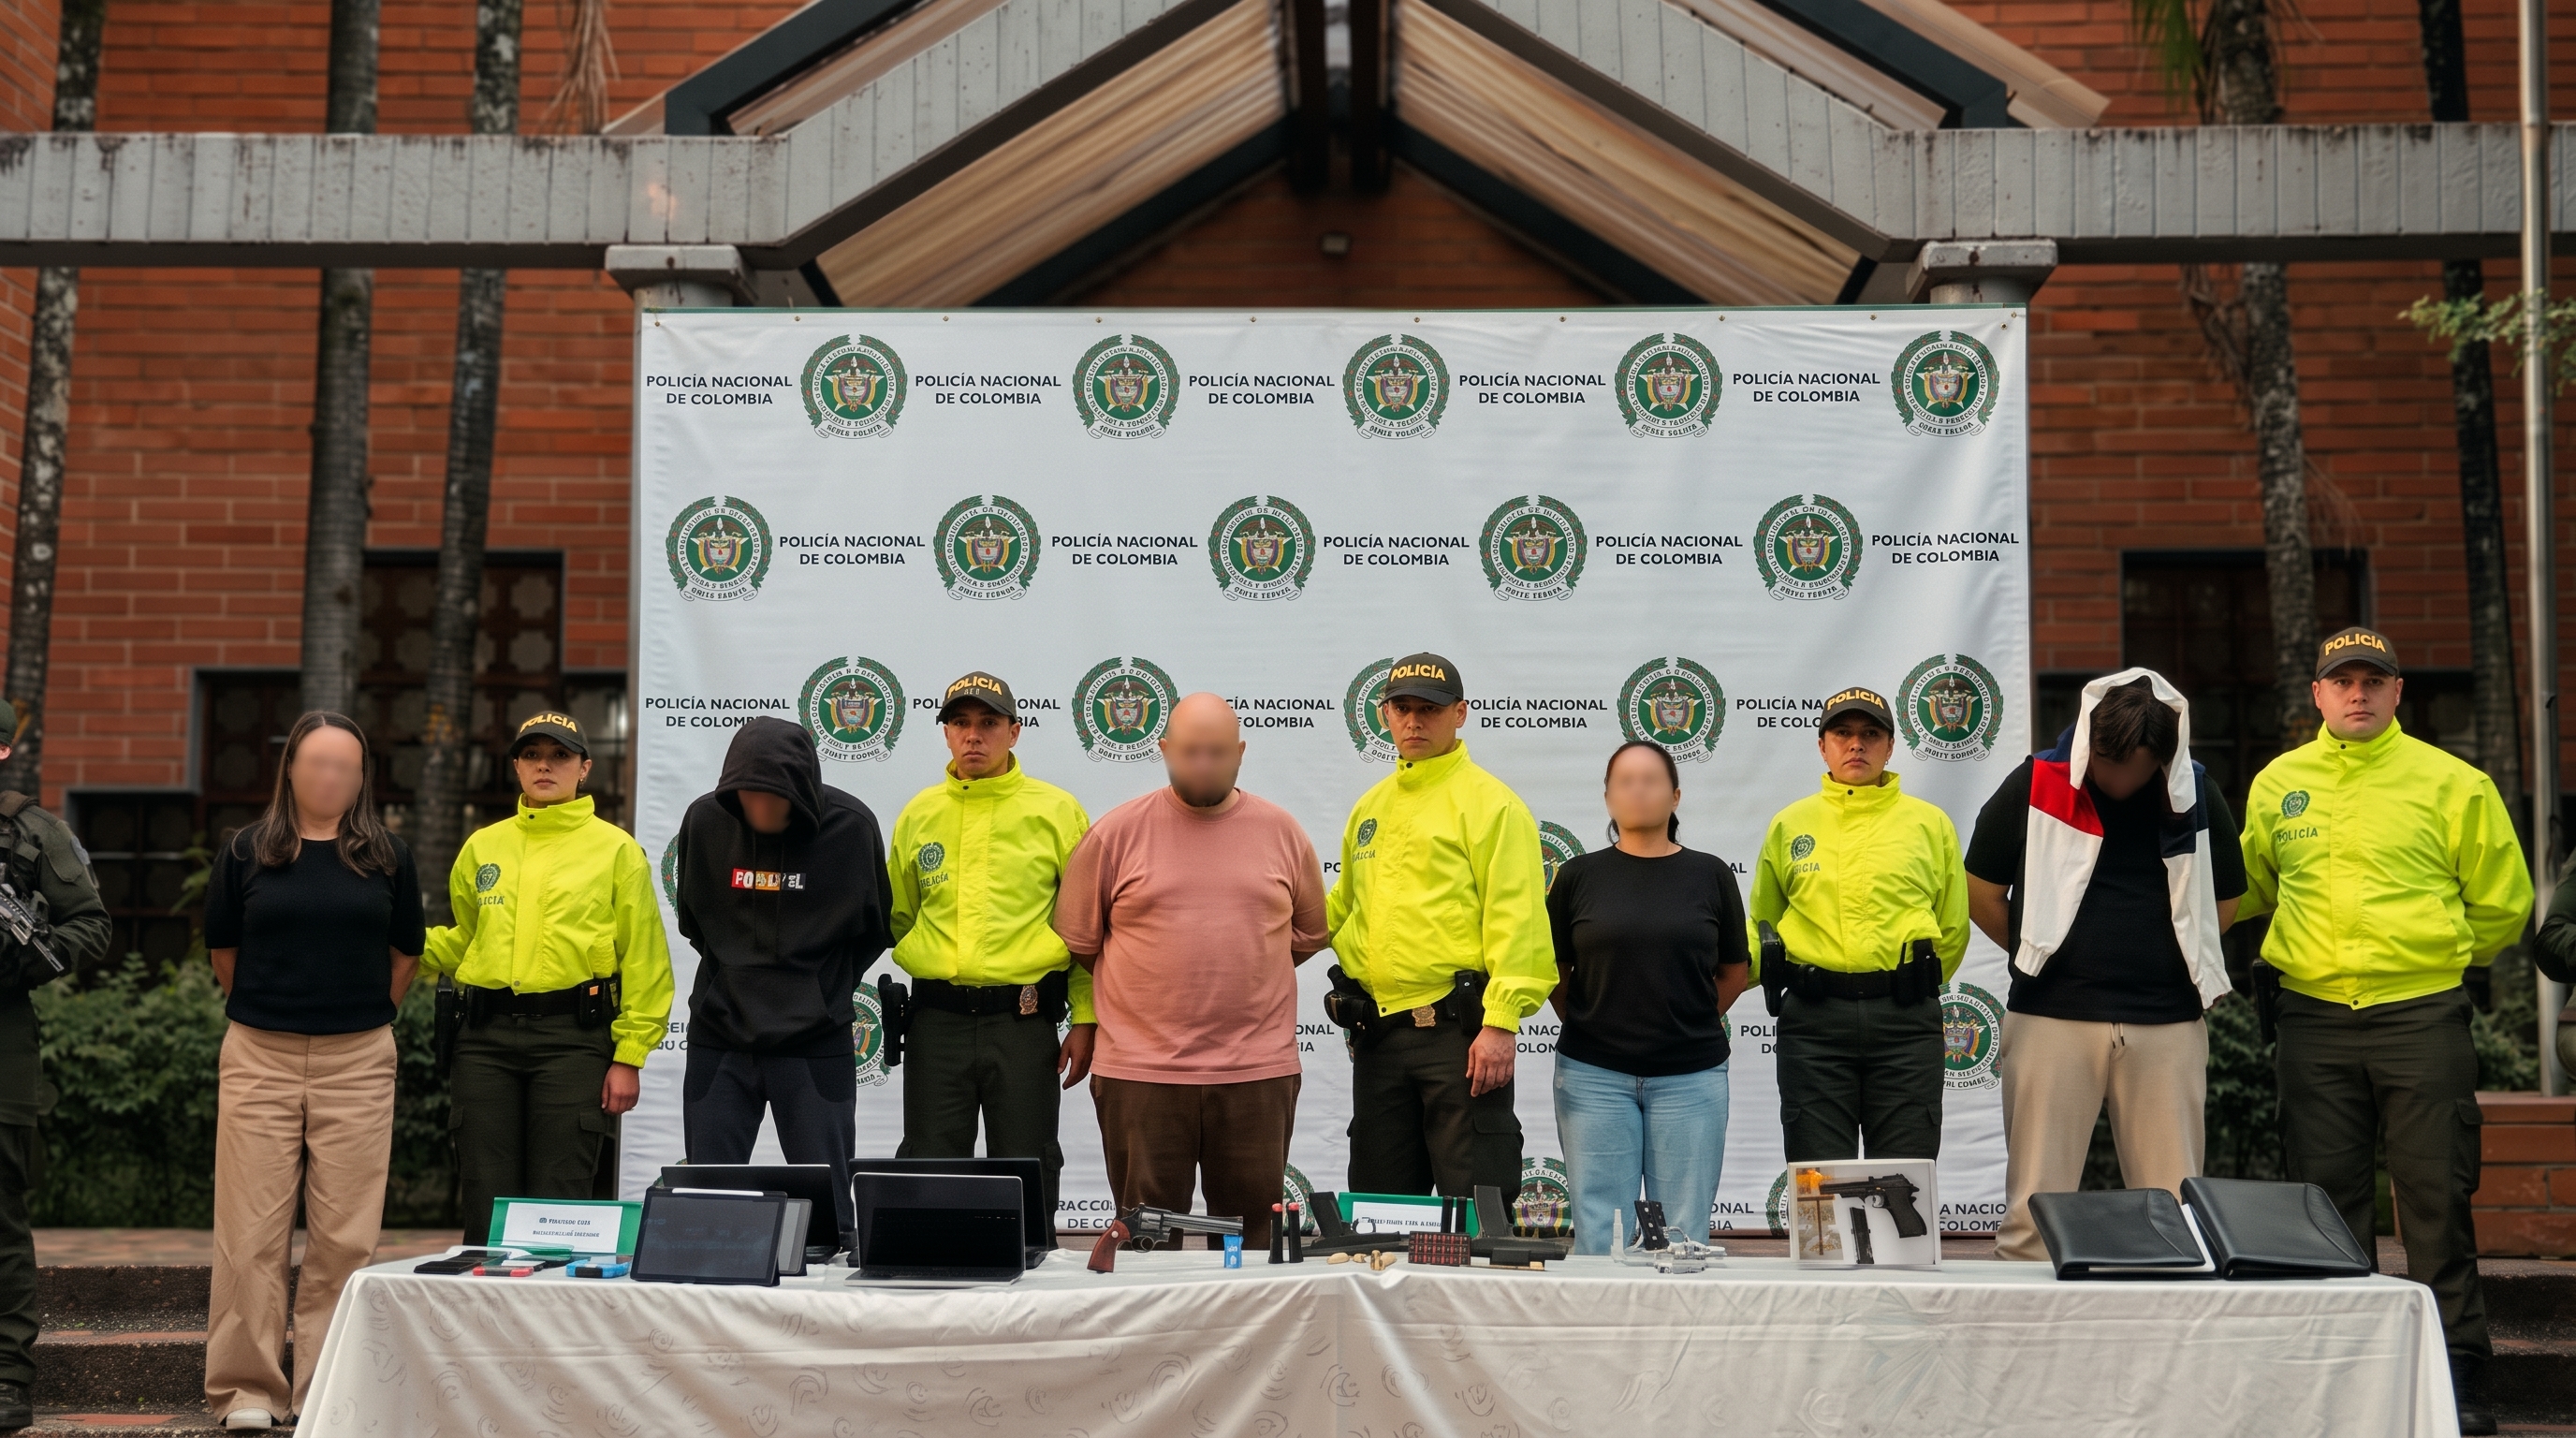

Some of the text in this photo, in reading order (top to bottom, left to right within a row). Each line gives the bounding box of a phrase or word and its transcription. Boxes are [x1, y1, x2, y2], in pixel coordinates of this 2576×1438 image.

[647, 374, 792, 388] POLICÍA NACIONAL
[916, 373, 1061, 387] POLICÍA NACIONAL
[1190, 373, 1335, 387] POLICÍA NACIONAL
[1460, 373, 1606, 386] POLICÍA NACIONAL
[1734, 371, 1881, 385] POLICÍA NACIONAL
[666, 393, 772, 404] DE COLOMBIA
[936, 393, 1041, 404] DE COLOMBIA
[1209, 393, 1314, 404] DE COLOMBIA
[1479, 392, 1585, 404] DE COLOMBIA
[1754, 390, 1860, 402] DE COLOMBIA
[780, 534, 925, 547] POLICÍA NACIONAL
[1052, 534, 1198, 547] POLICÍA NACIONAL
[1324, 534, 1470, 548] POLICÍA NACIONAL
[1596, 534, 1743, 547] POLICÍA NACIONAL
[1872, 533, 2019, 546] POLICÍA NACIONAL
[800, 553, 905, 565] DE COLOMBIA
[1073, 554, 1178, 565] DE COLOMBIA
[1344, 554, 1449, 565] DE COLOMBIA
[1617, 553, 1722, 565] DE COLOMBIA
[1893, 550, 1999, 564] DE COLOMBIA
[646, 697, 790, 710] POLICÍA NACIONAL
[1254, 699, 1335, 710] NACIONAL
[1527, 699, 1607, 710] NACIONAL
[1737, 697, 1797, 710] POLICÍA
[666, 716, 755, 727] DE COLOM
[1238, 717, 1314, 727] OLOMBIA
[1482, 717, 1588, 727] DE COLOMBIA
[1758, 717, 1821, 727] DE COLO
[1740, 1025, 1777, 1036] POLI
[1955, 1204, 2006, 1214] NACIO
[1068, 1219, 1089, 1229] DE
